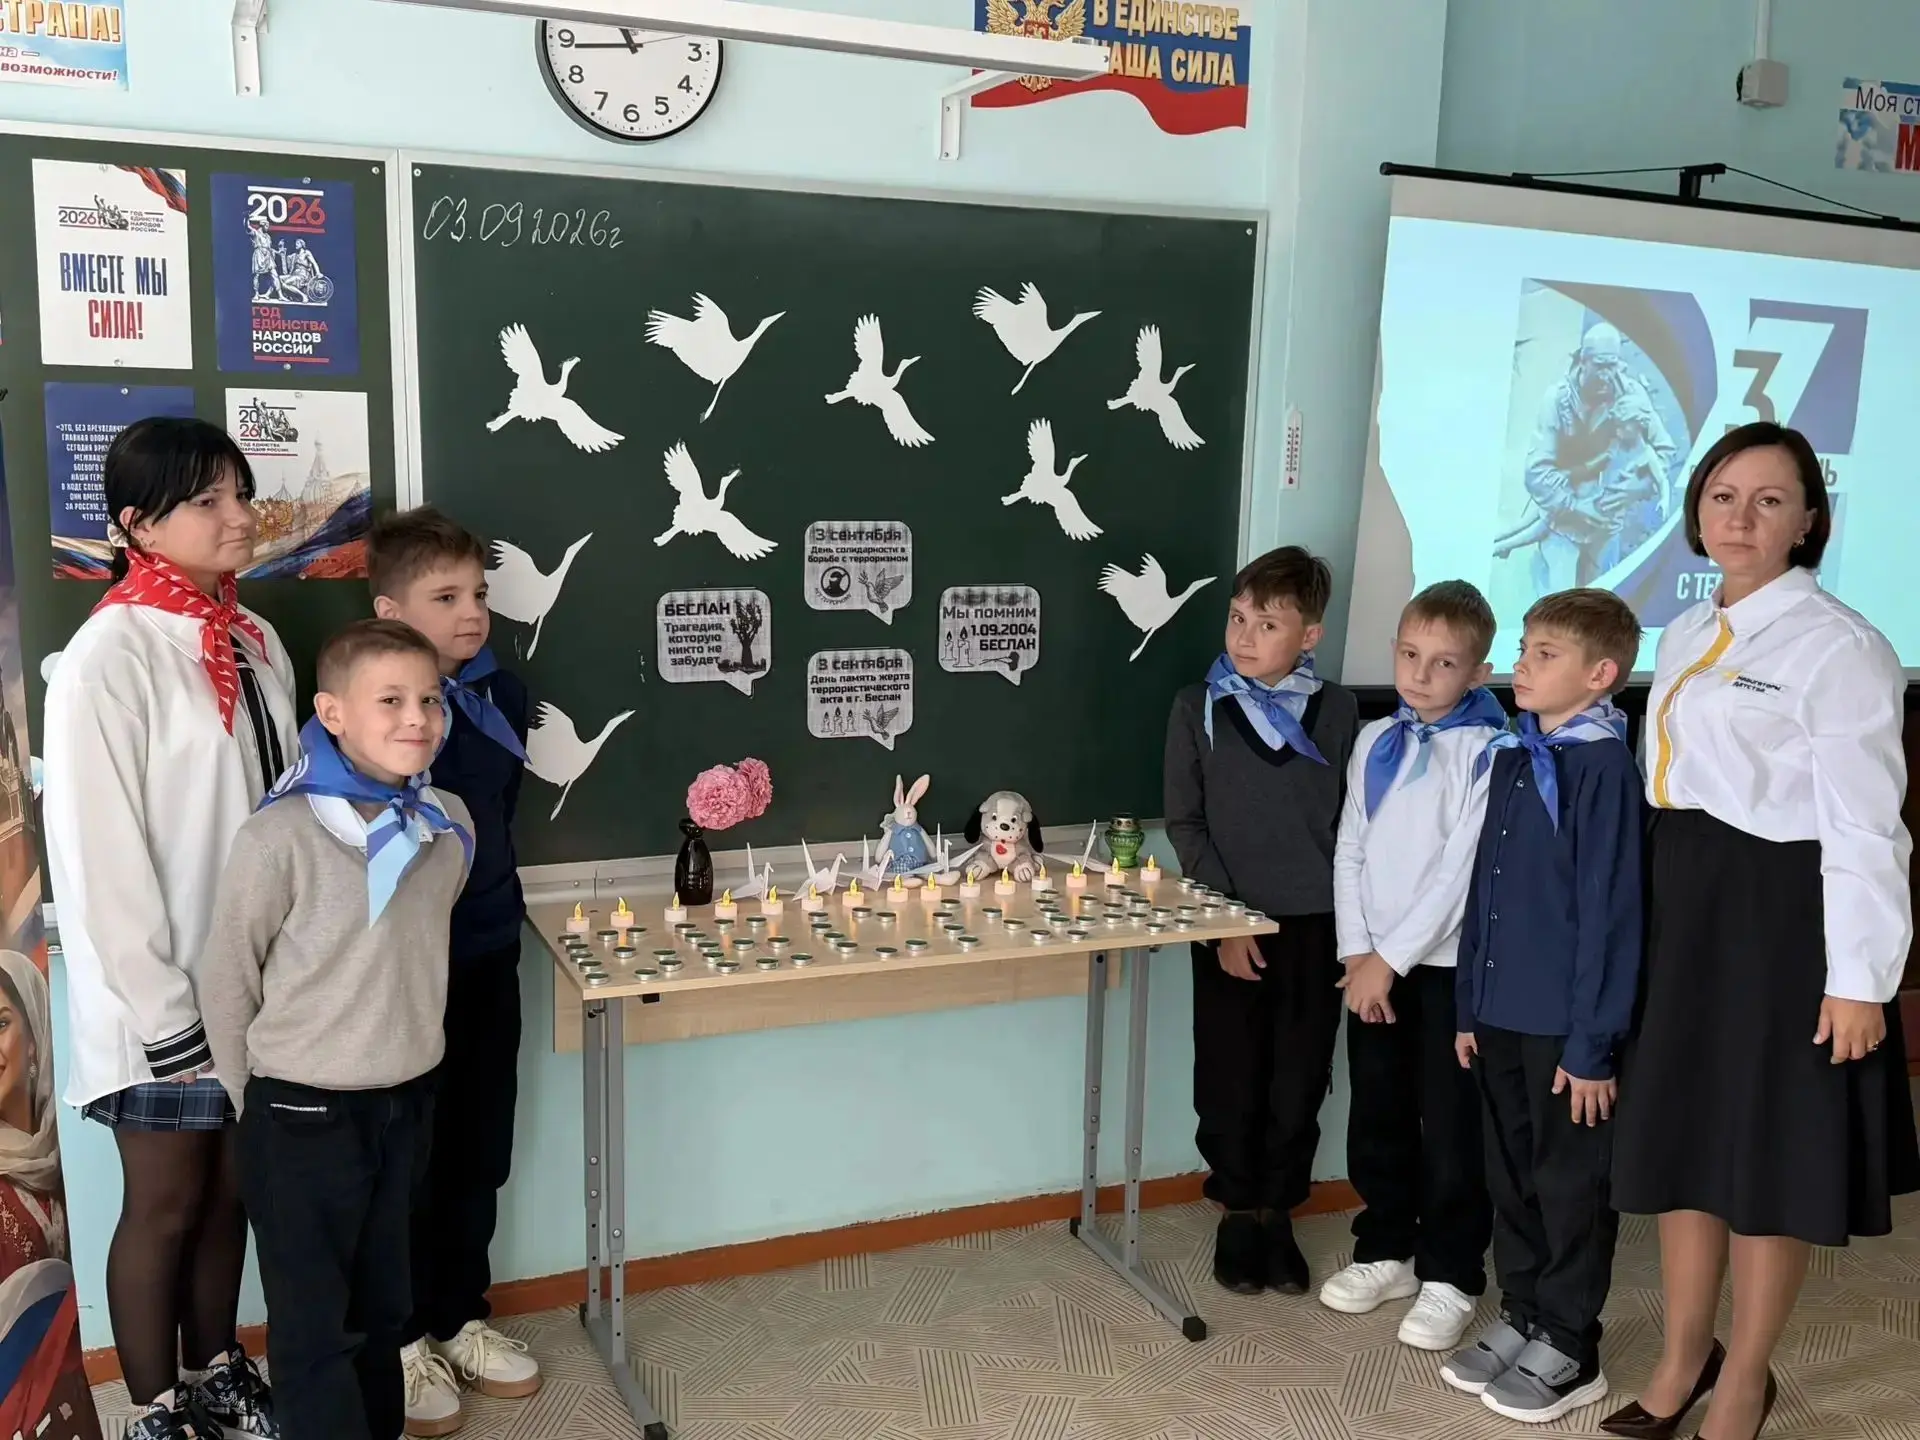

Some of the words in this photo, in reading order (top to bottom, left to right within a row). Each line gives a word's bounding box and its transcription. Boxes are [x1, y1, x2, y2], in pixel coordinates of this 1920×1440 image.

[0, 0, 121, 42] ТРАНА!
[1093, 0, 1109, 26] В
[1114, 0, 1240, 41] ЕДИНСТВЕ
[557, 28, 576, 48] 9
[687, 42, 702, 62] 3
[1094, 39, 1162, 80] АША
[1171, 48, 1236, 86] СИЛА
[568, 64, 585, 84] 8
[677, 75, 693, 94] 4
[594, 91, 609, 110] 7
[654, 96, 669, 115] 5
[1856, 86, 1897, 112] Моя
[623, 104, 640, 122] 6
[248, 193, 325, 225] 2026
[58, 209, 97, 225] 2026
[59, 252, 125, 294] ВМЕСТЕ
[135, 256, 167, 296] МЫ
[88, 299, 143, 340] СИЛА!
[251, 306, 281, 318] ГОД
[252, 318, 328, 332] ЕДИНСТВА
[252, 330, 322, 343] НАРОДОВ
[252, 342, 313, 354] РОССИИ
[239, 409, 258, 423] 20
[239, 423, 259, 437] 26
[815, 528, 825, 541] 3
[831, 528, 902, 543] сентября
[811, 546, 834, 554] День
[836, 546, 899, 554] солидарности
[808, 555, 840, 563] борьбе
[1676, 572, 1691, 600] С
[664, 602, 730, 617] БЕСЛАН
[943, 606, 969, 619] Мы
[974, 607, 1036, 619] помним
[664, 622, 725, 634] Трагедия,
[971, 623, 1037, 636] 1.09.2004
[668, 634, 722, 645] которую
[979, 638, 1036, 651] БЕСЛАН
[668, 645, 704, 655] никто
[707, 645, 722, 653] не
[670, 655, 720, 667] забудет
[832, 656, 903, 671] сентября
[810, 675, 837, 685] День
[839, 674, 877, 683] память
[879, 673, 910, 683] жертв
[811, 683, 910, 695] террористического
[820, 696, 844, 704] акта
[865, 693, 901, 702] Беслан
